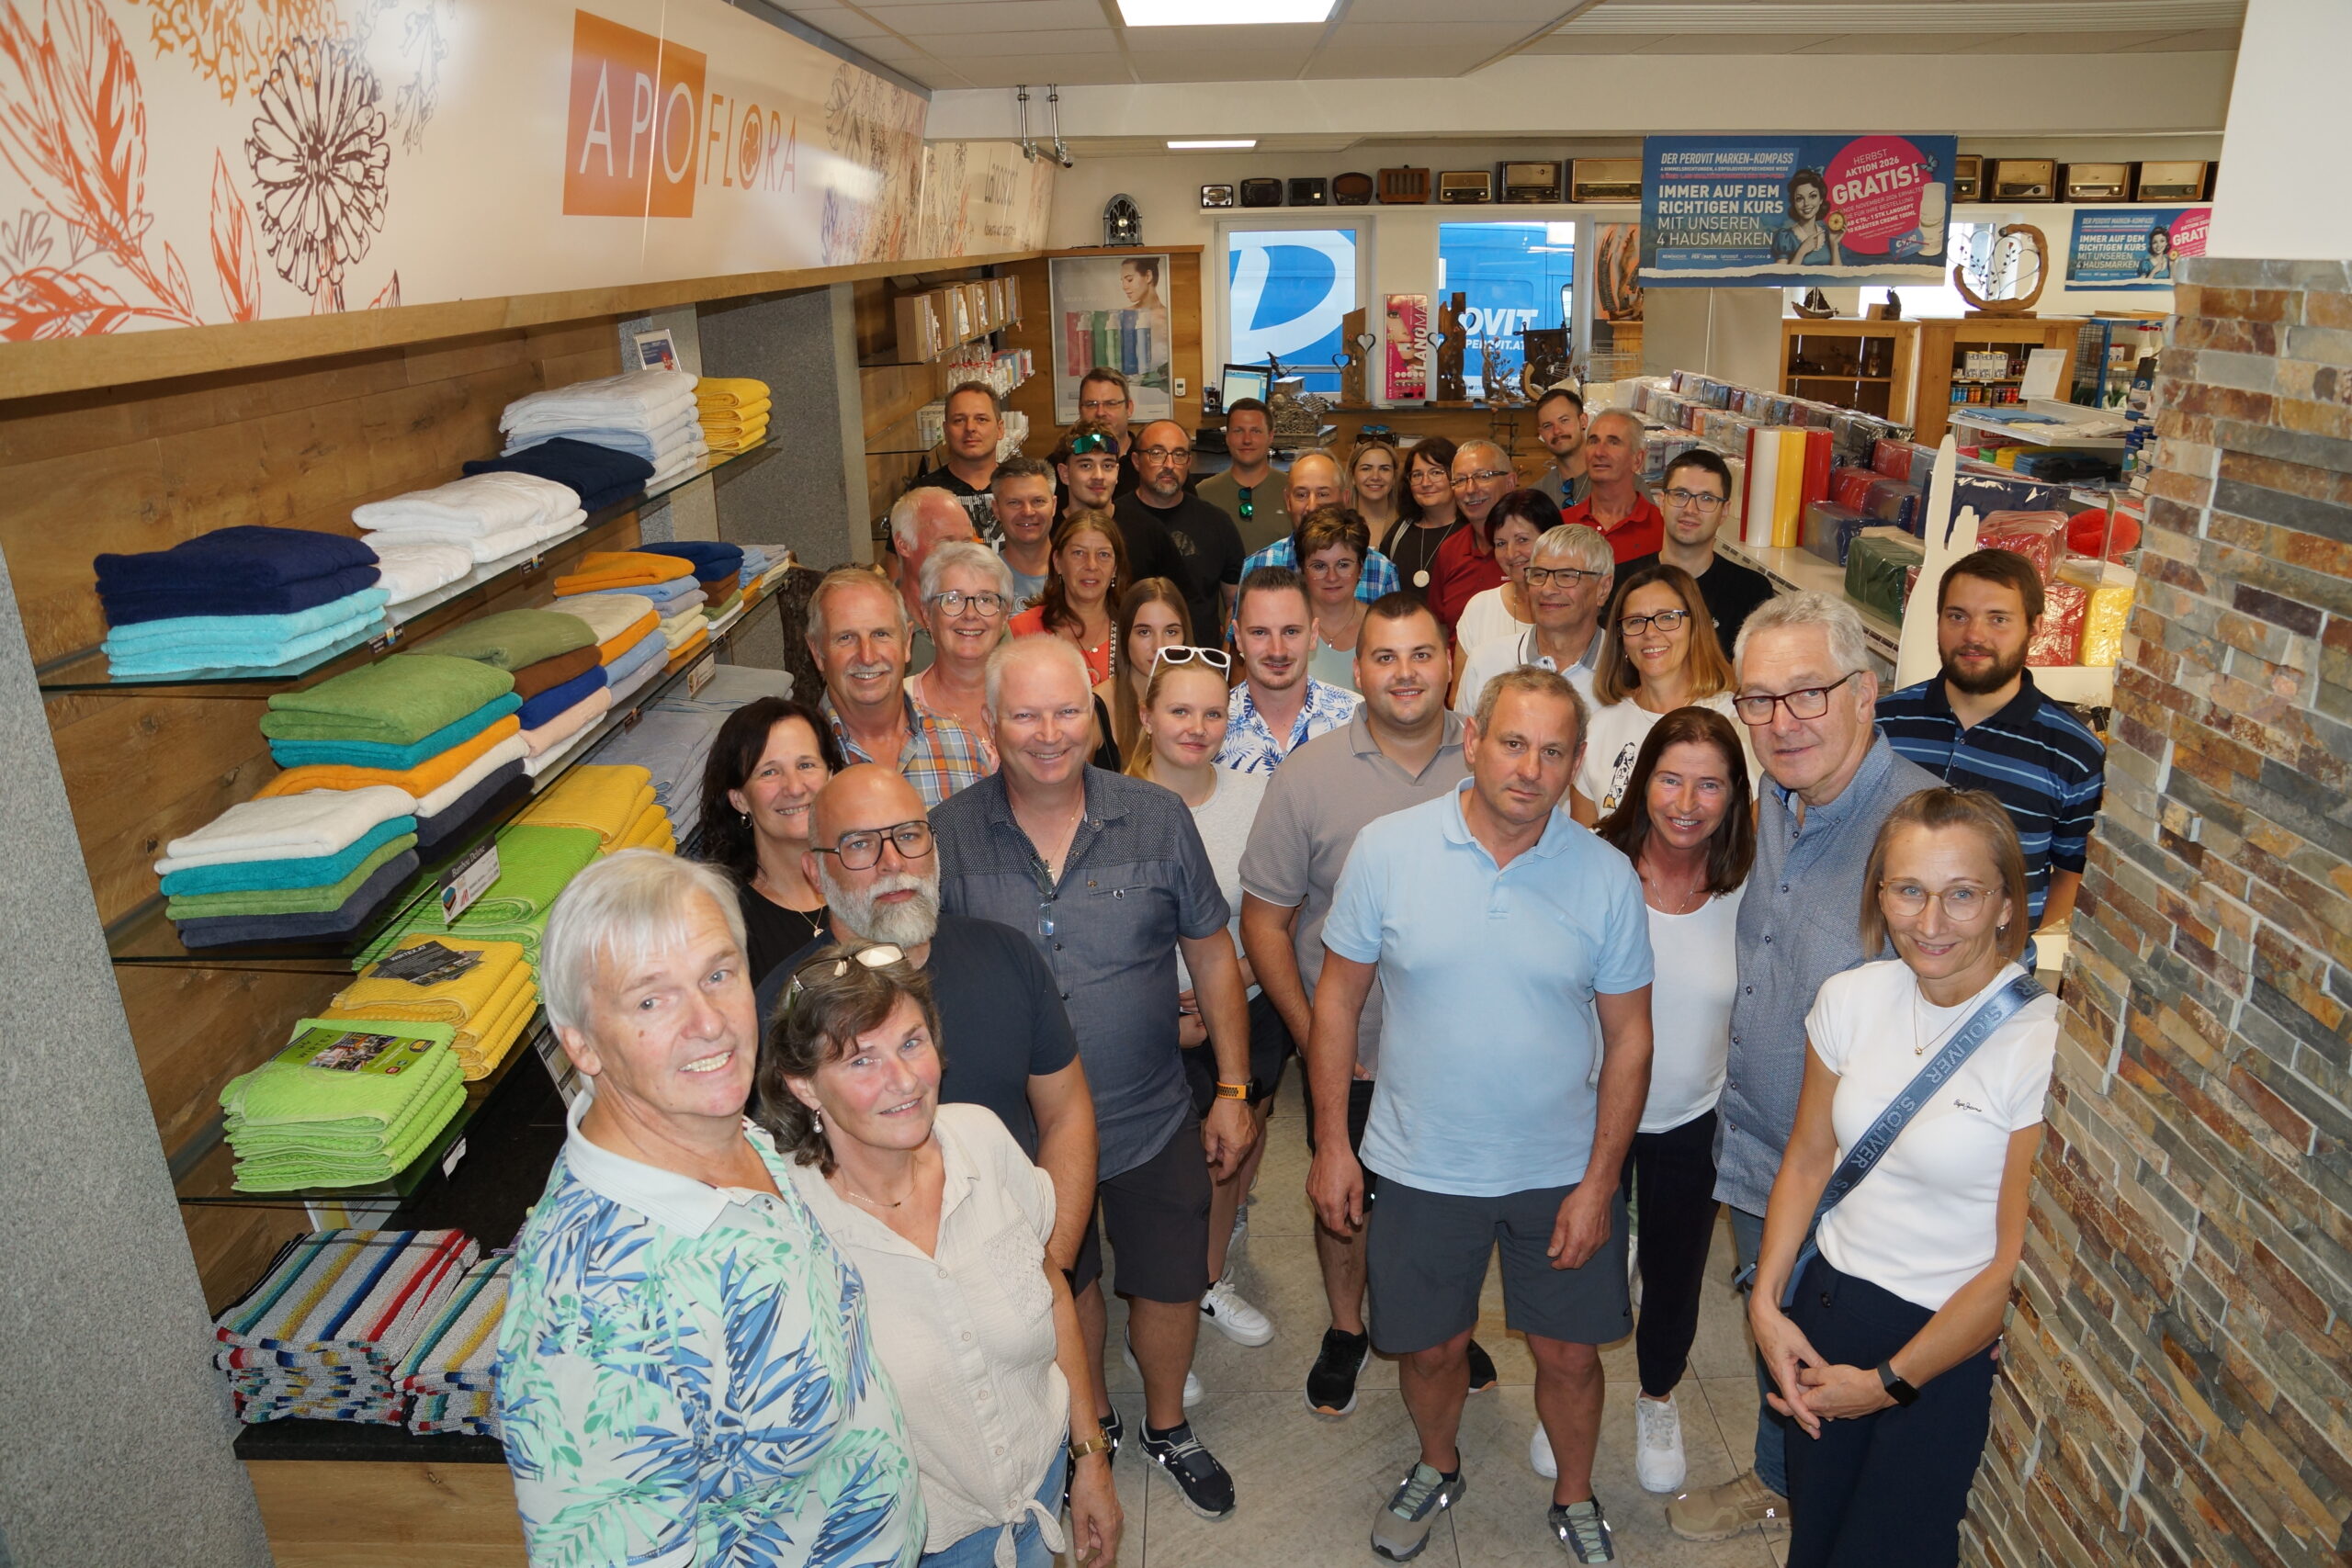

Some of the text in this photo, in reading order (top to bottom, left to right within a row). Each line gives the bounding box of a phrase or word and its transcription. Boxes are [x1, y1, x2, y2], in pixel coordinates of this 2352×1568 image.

[579, 58, 797, 195] APOFLORA
[1660, 152, 1794, 164] DER PEROVIT MARKEN-KOMPASS
[1853, 148, 1888, 165] HERBST
[1846, 156, 1900, 178] AKTION 2026
[1832, 163, 1920, 205] GRATIS!
[1658, 185, 1780, 198] IMMER AUF DEM
[1658, 200, 1784, 214] RICHTIGEN KURS
[1657, 216, 1760, 230] MIT UNSEREN
[1657, 231, 1774, 245] 4 HAUSMARKEN
[2080, 234, 2145, 243] IMMER AUF DEM
[2173, 225, 2210, 246] GRATI
[2078, 243, 2147, 252] RICHTIGEN KURS
[2077, 252, 2133, 260] MIT UNSEREN
[2083, 261, 2140, 269] HAUSMARKEN
[1458, 307, 1539, 337] OVIT
[1926, 1005, 2004, 1085] S.OLIVER
[1850, 1095, 1917, 1169] S.OLIVER
